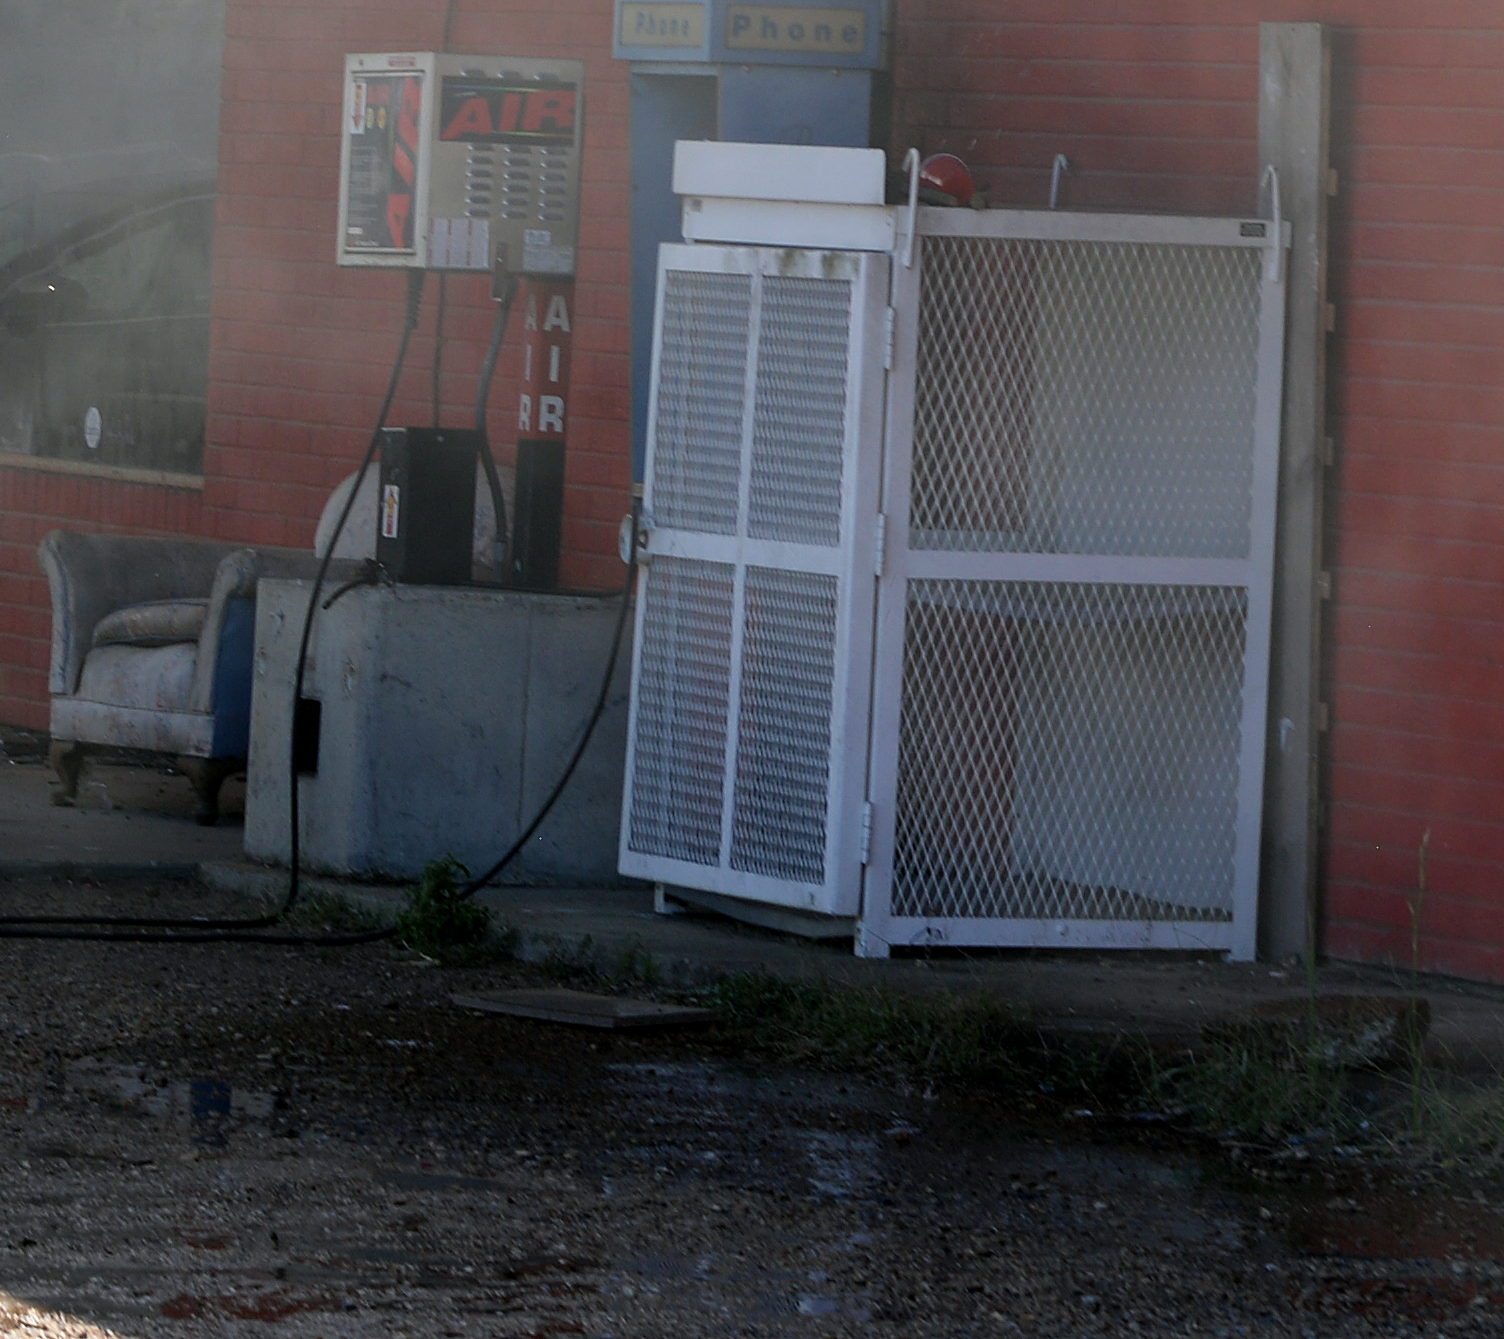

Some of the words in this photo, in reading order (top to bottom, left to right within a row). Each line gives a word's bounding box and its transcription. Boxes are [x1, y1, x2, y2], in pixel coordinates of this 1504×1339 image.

[635, 12, 690, 38] Phone
[731, 14, 859, 43] Phone
[440, 90, 576, 140] AIR
[518, 294, 537, 431] AIR
[538, 295, 571, 433] AIR
